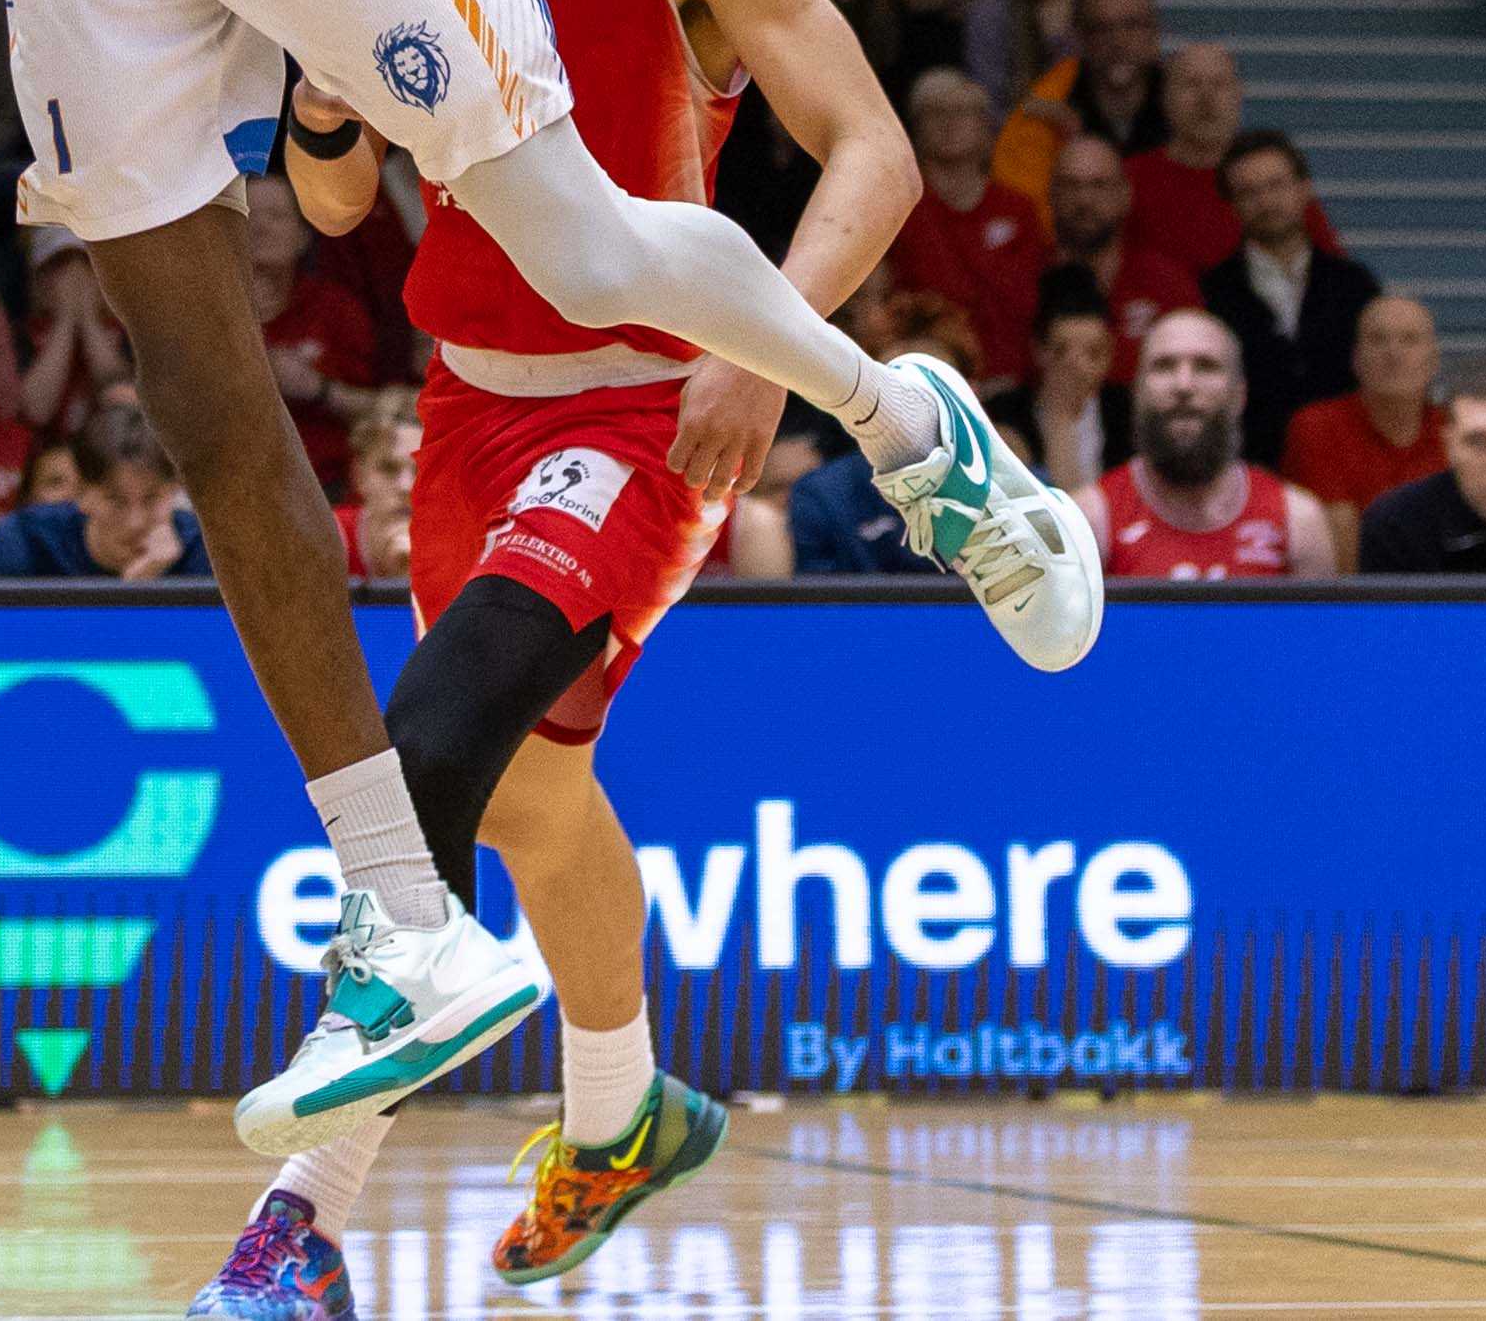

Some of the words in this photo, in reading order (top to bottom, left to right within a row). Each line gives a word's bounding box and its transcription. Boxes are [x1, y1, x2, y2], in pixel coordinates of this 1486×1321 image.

[47, 98, 73, 175] 1
[786, 1022, 866, 1089] By
[885, 1021, 1190, 1078] Haltbakk
